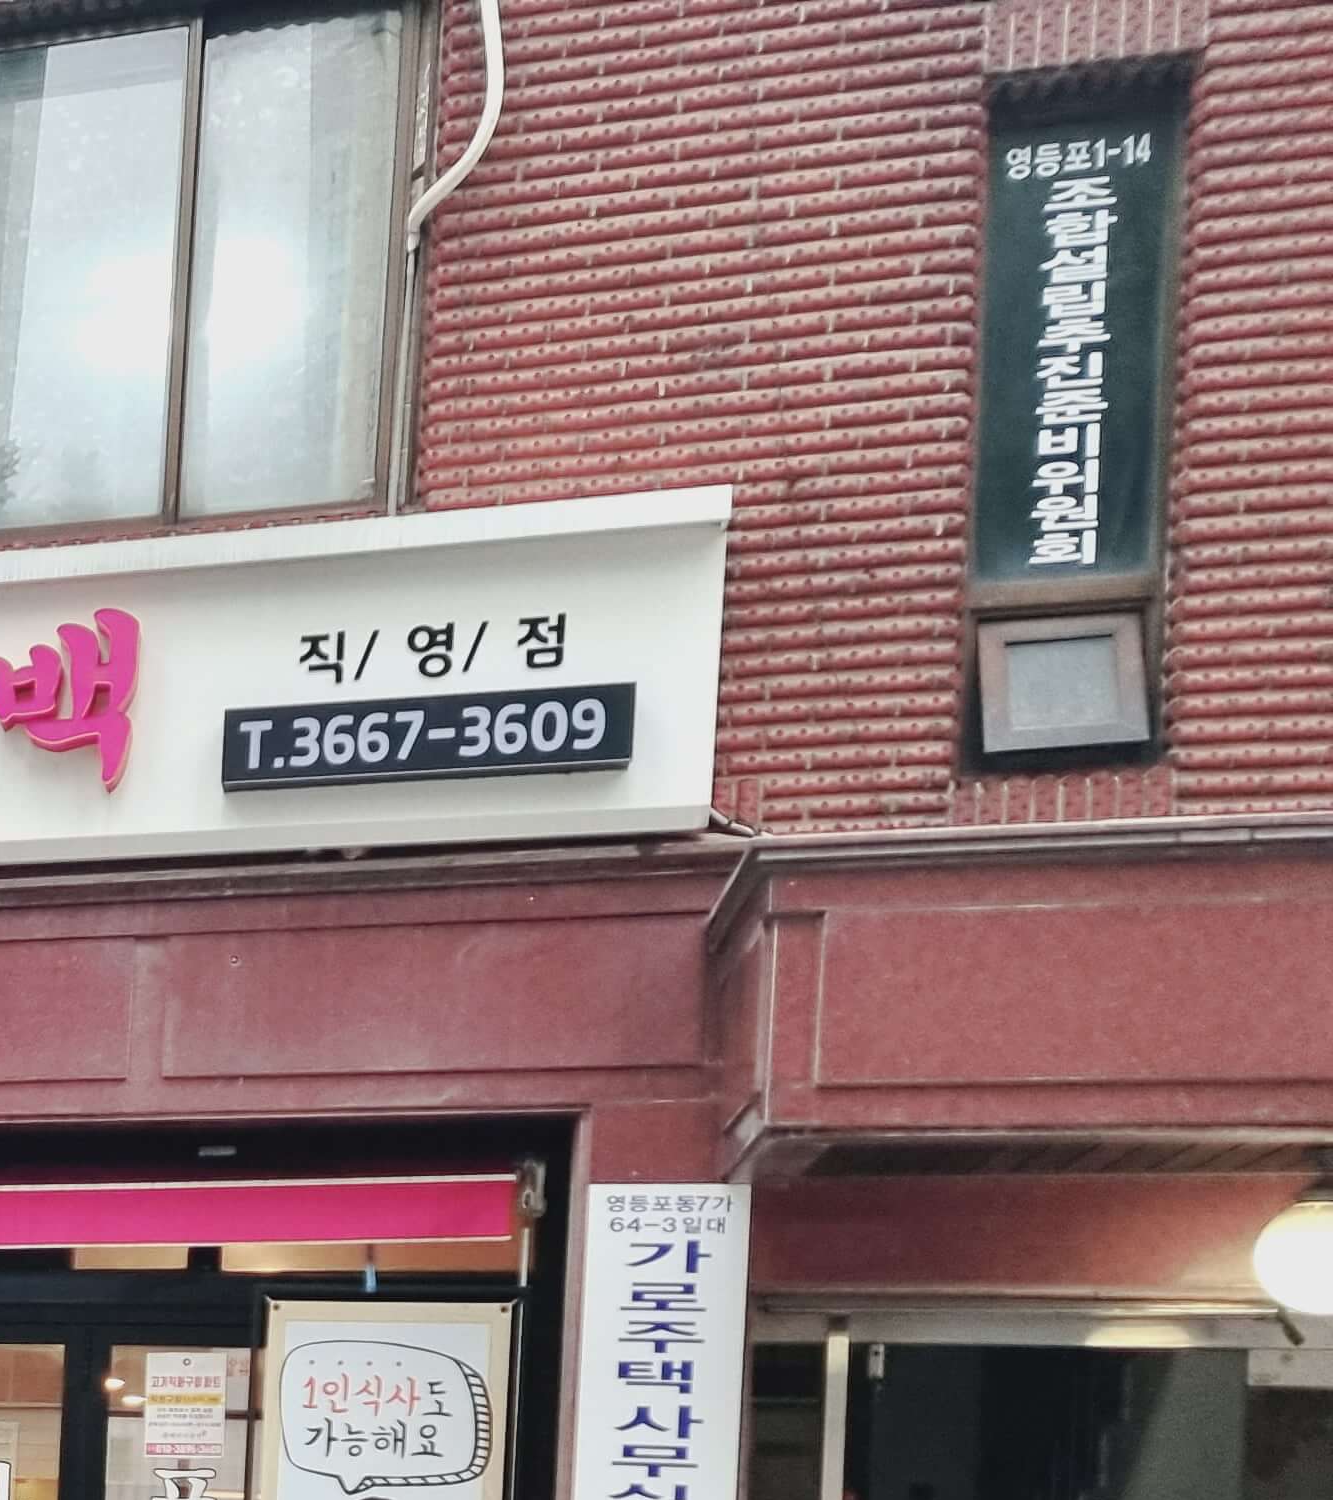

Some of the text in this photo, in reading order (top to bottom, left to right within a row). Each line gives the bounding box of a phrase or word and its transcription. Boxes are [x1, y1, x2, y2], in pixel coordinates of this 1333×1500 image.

[1006, 132, 1152, 180] 영등포1-14
[1029, 176, 1119, 565] 조합설립추진준비위원회
[239, 697, 607, 769] T.3667-3609
[606, 1194, 734, 1213] 영등포동7가
[302, 1372, 453, 1417] 1인식사도
[304, 1418, 444, 1459] 가능해요
